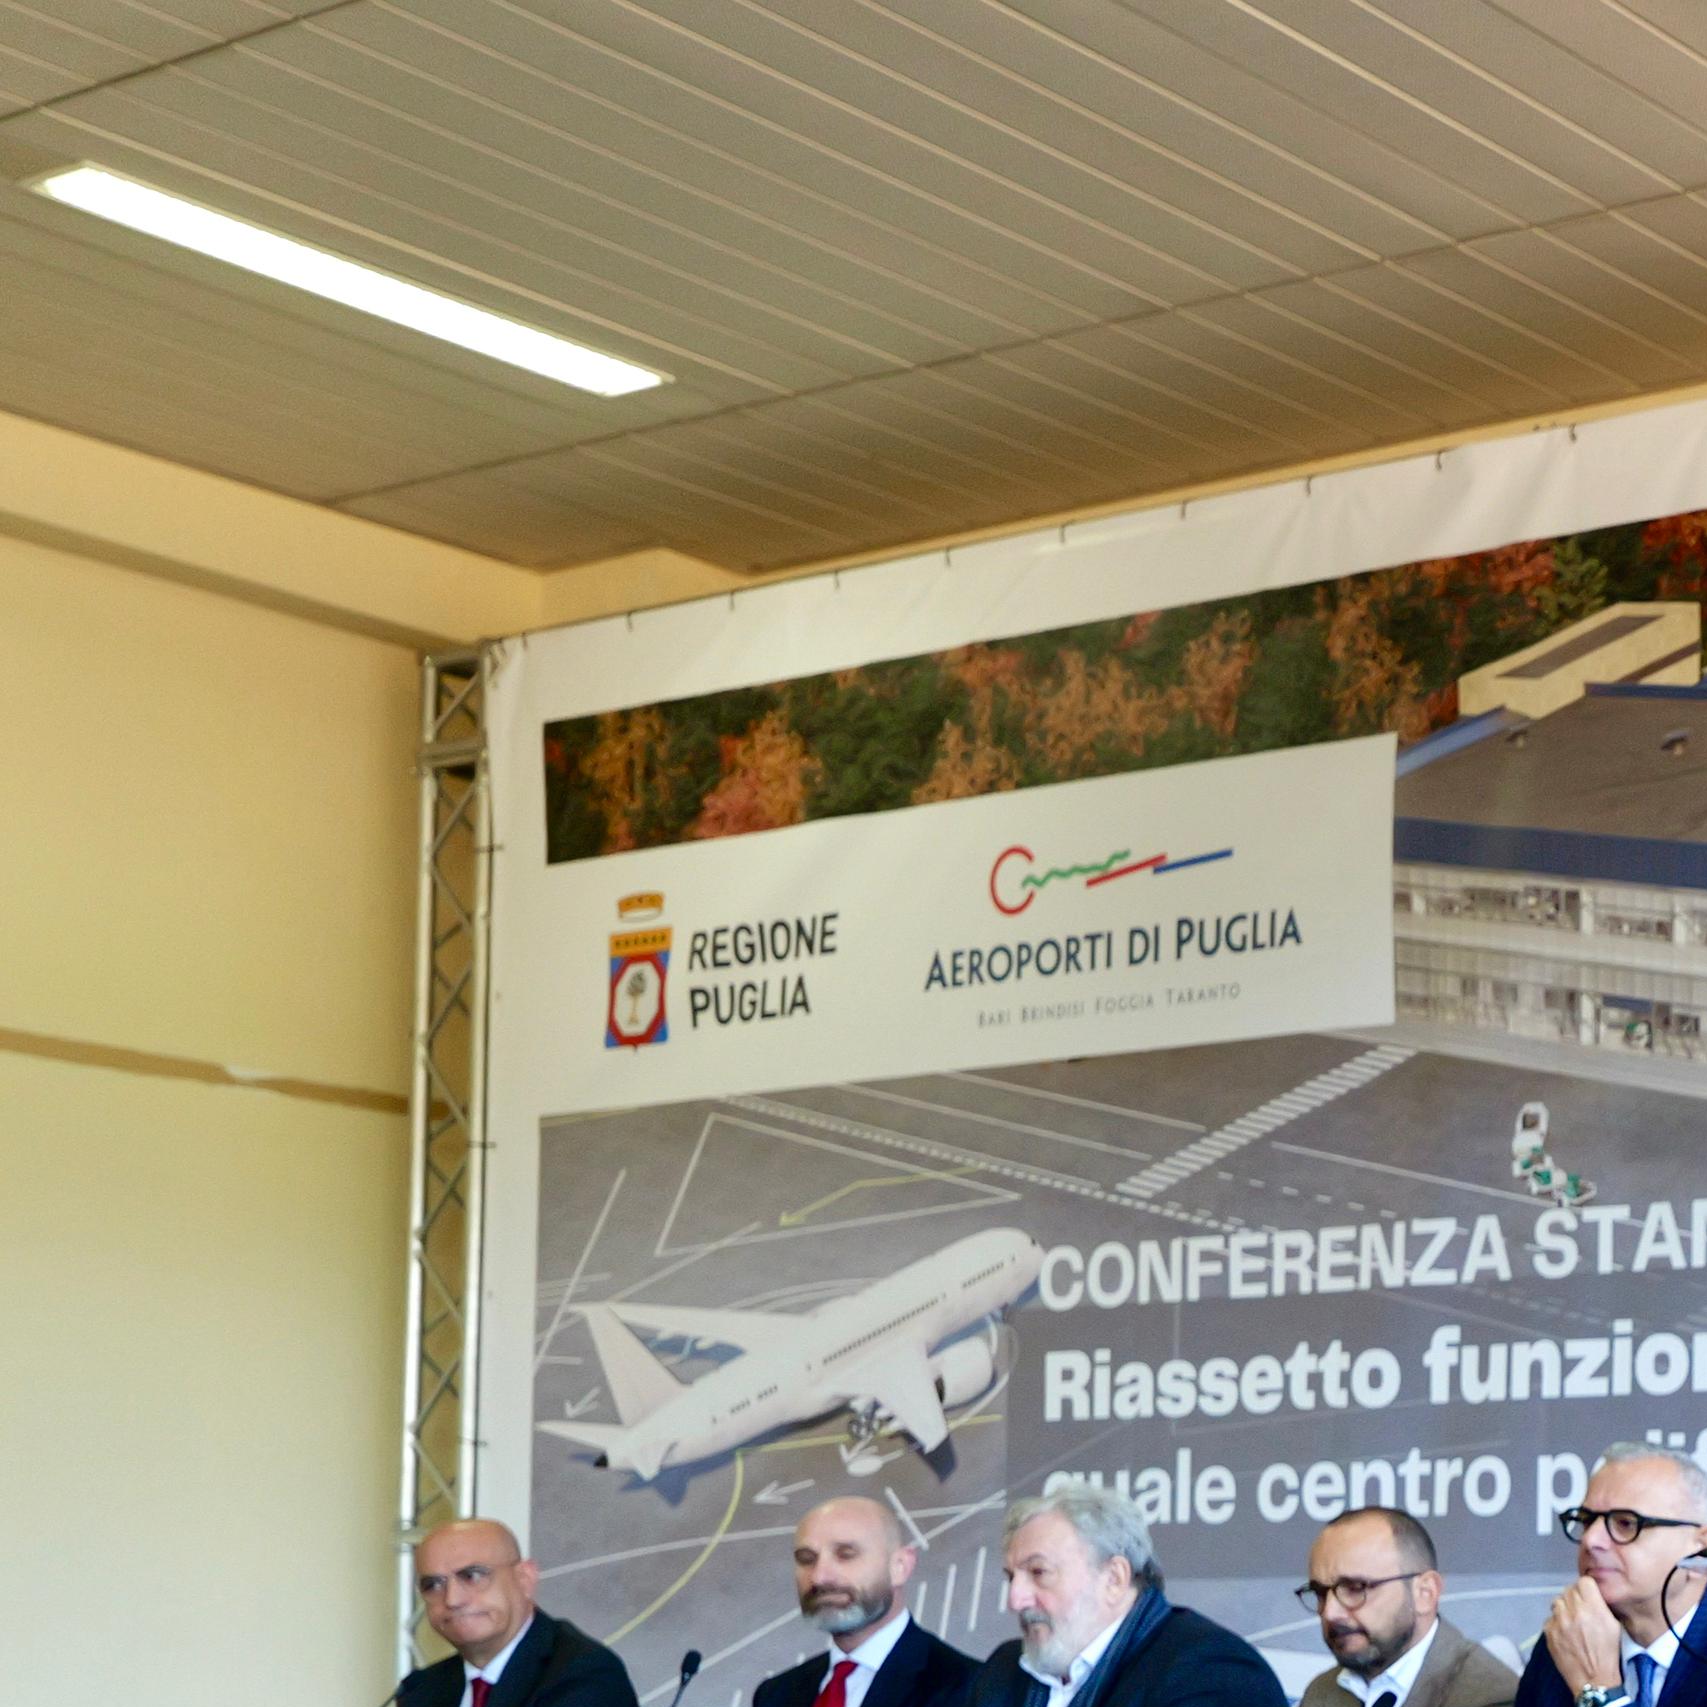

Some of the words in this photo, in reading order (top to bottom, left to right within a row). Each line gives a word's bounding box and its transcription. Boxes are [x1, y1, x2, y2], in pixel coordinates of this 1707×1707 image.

[688, 911, 840, 972] REGIONE
[924, 934, 1116, 993] AEROPORTI
[1127, 923, 1162, 964] DI
[1175, 907, 1302, 957] PUGLIA
[690, 974, 812, 1029] PUGLIA
[1164, 982, 1242, 1007] TARANTO
[1038, 1213, 1511, 1312] CONFERENZA
[1043, 1338, 1400, 1423] Riassetto
[1256, 1431, 1511, 1521] centro
